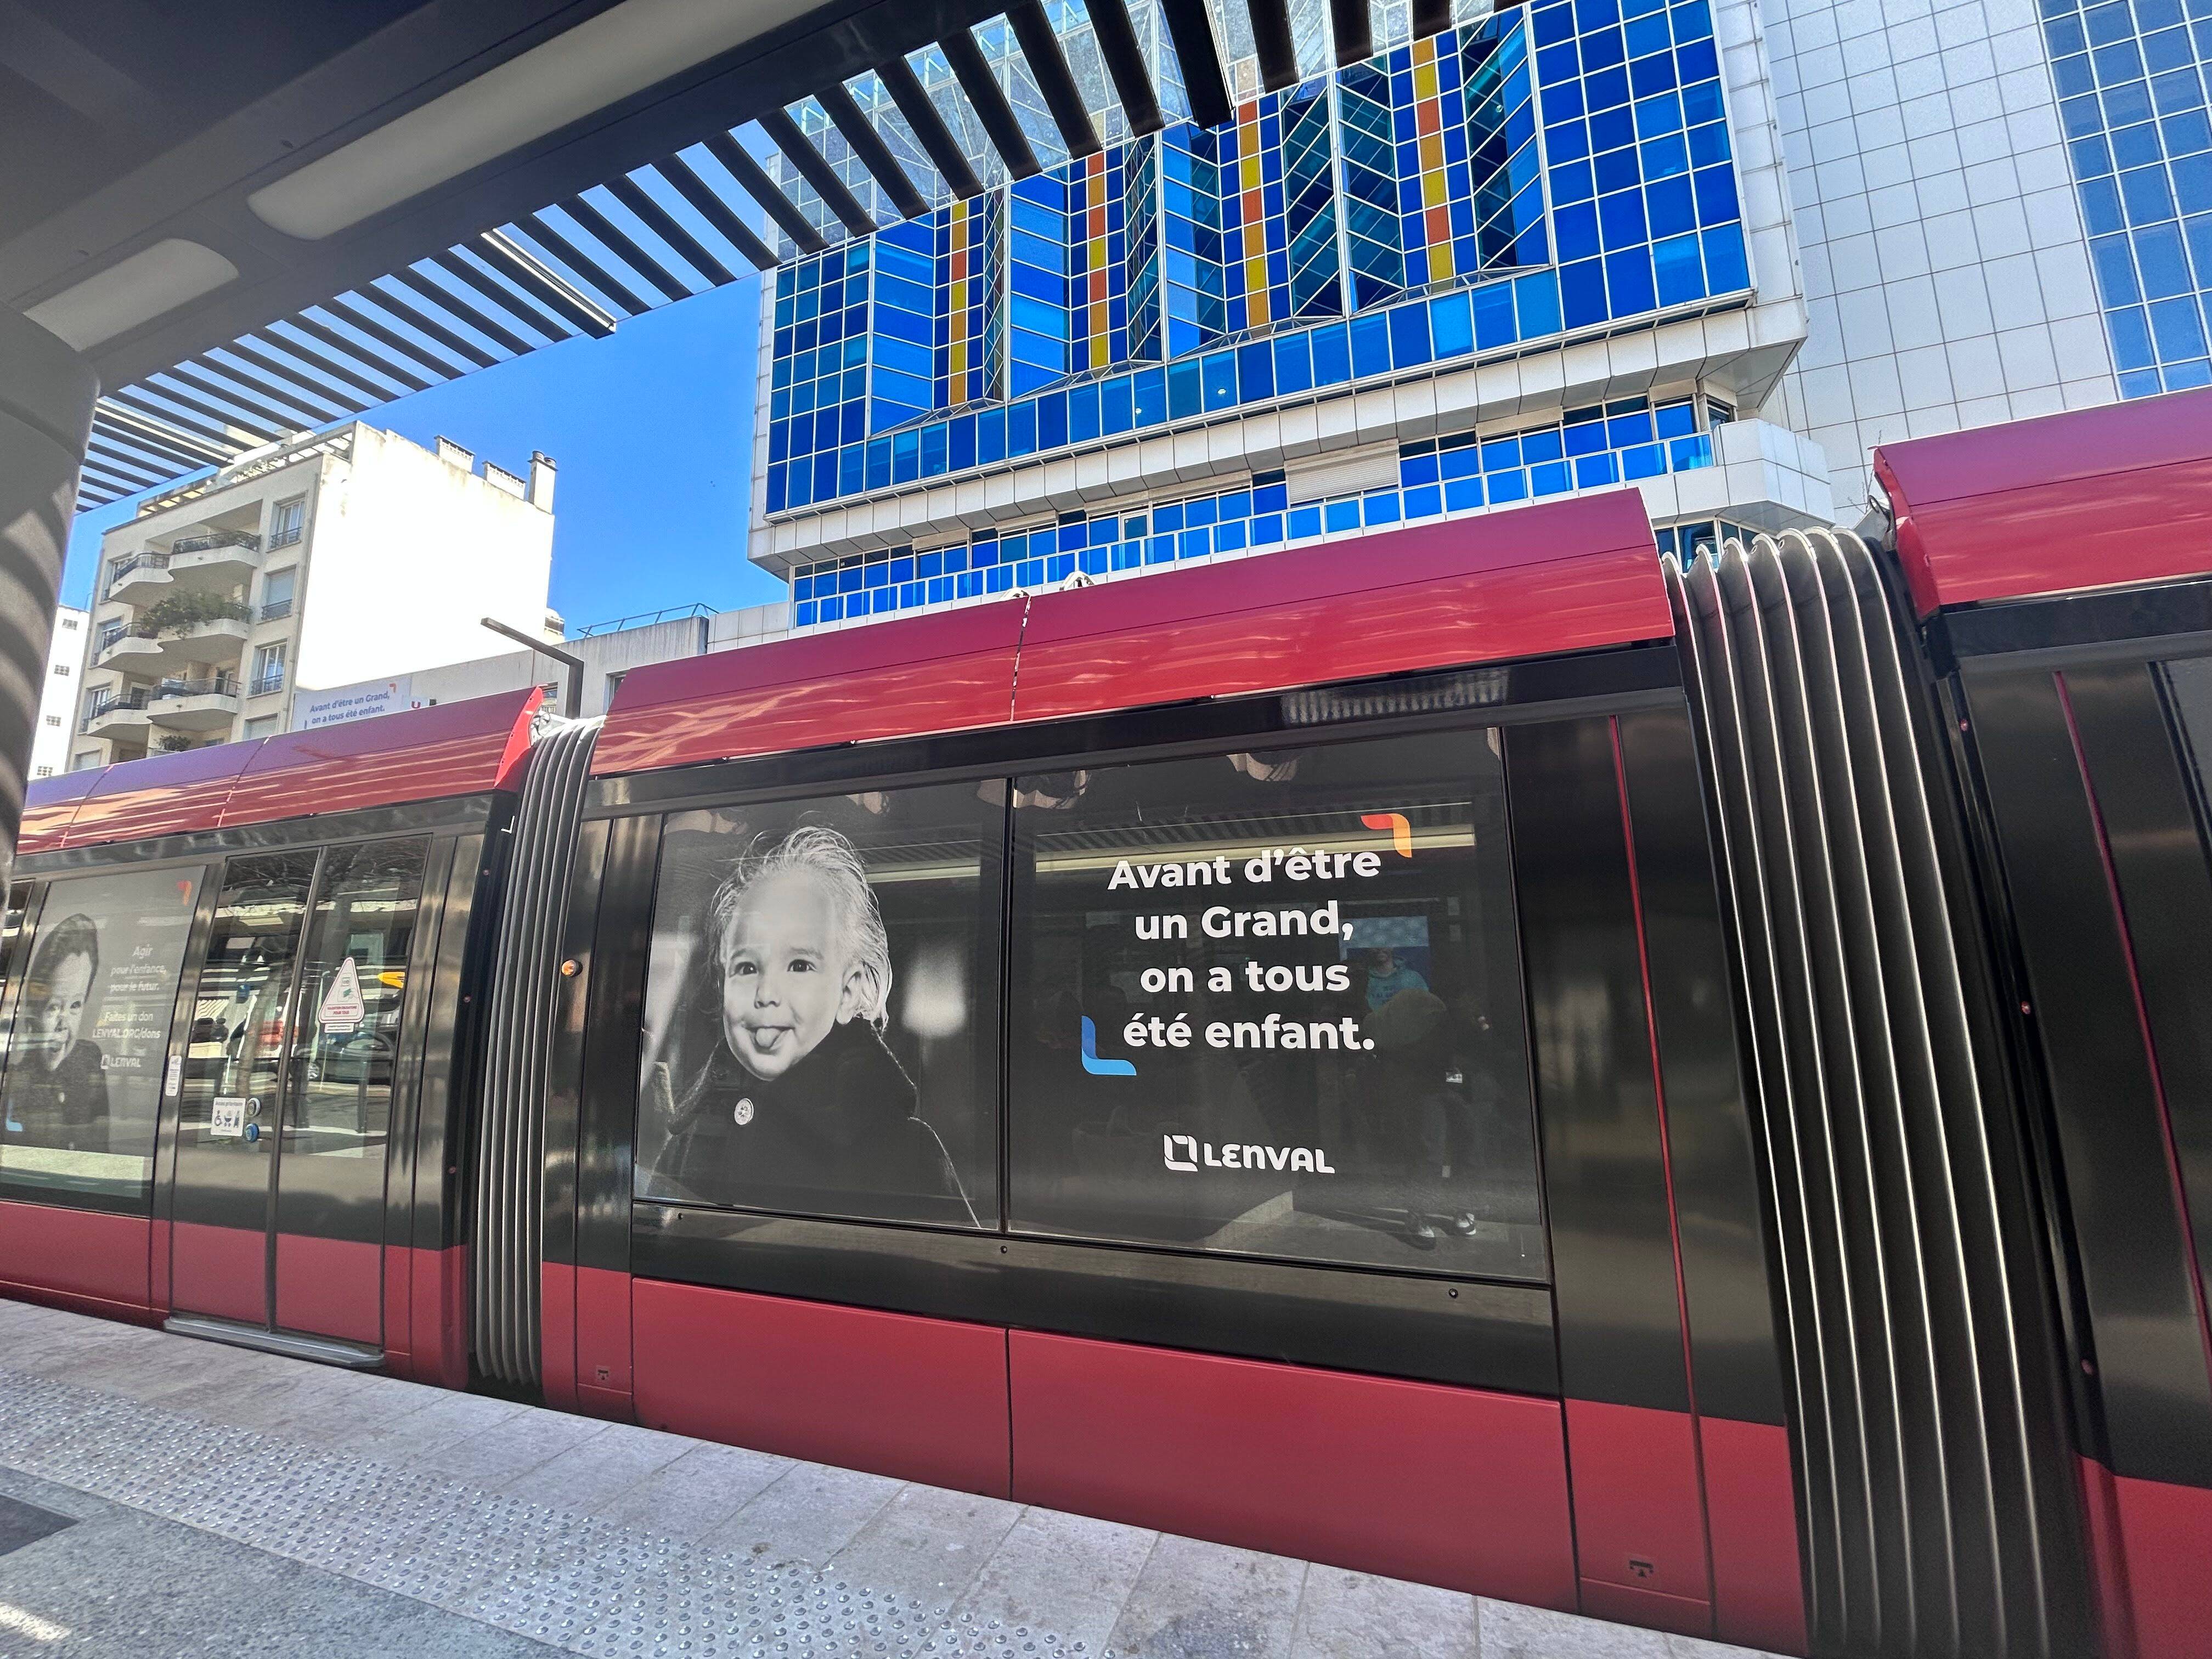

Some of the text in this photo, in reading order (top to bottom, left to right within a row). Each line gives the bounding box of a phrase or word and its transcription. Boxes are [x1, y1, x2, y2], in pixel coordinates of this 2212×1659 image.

[309, 703, 330, 713] Avant
[365, 690, 390, 702] Grand,
[329, 713, 344, 721] tous
[346, 709, 358, 718] été
[359, 704, 385, 716] enfant.
[1108, 855, 1232, 890] Avant
[1136, 900, 1354, 941] un Grand,
[132, 944, 153, 959] Agir
[1141, 961, 1350, 992] on a tous
[104, 1012, 126, 1022] Faites
[138, 1012, 153, 1022] don
[1124, 1013, 1375, 1050] été enfant.
[110, 1057, 141, 1068] LENVAL
[1204, 1142, 1335, 1174] LENVAL
